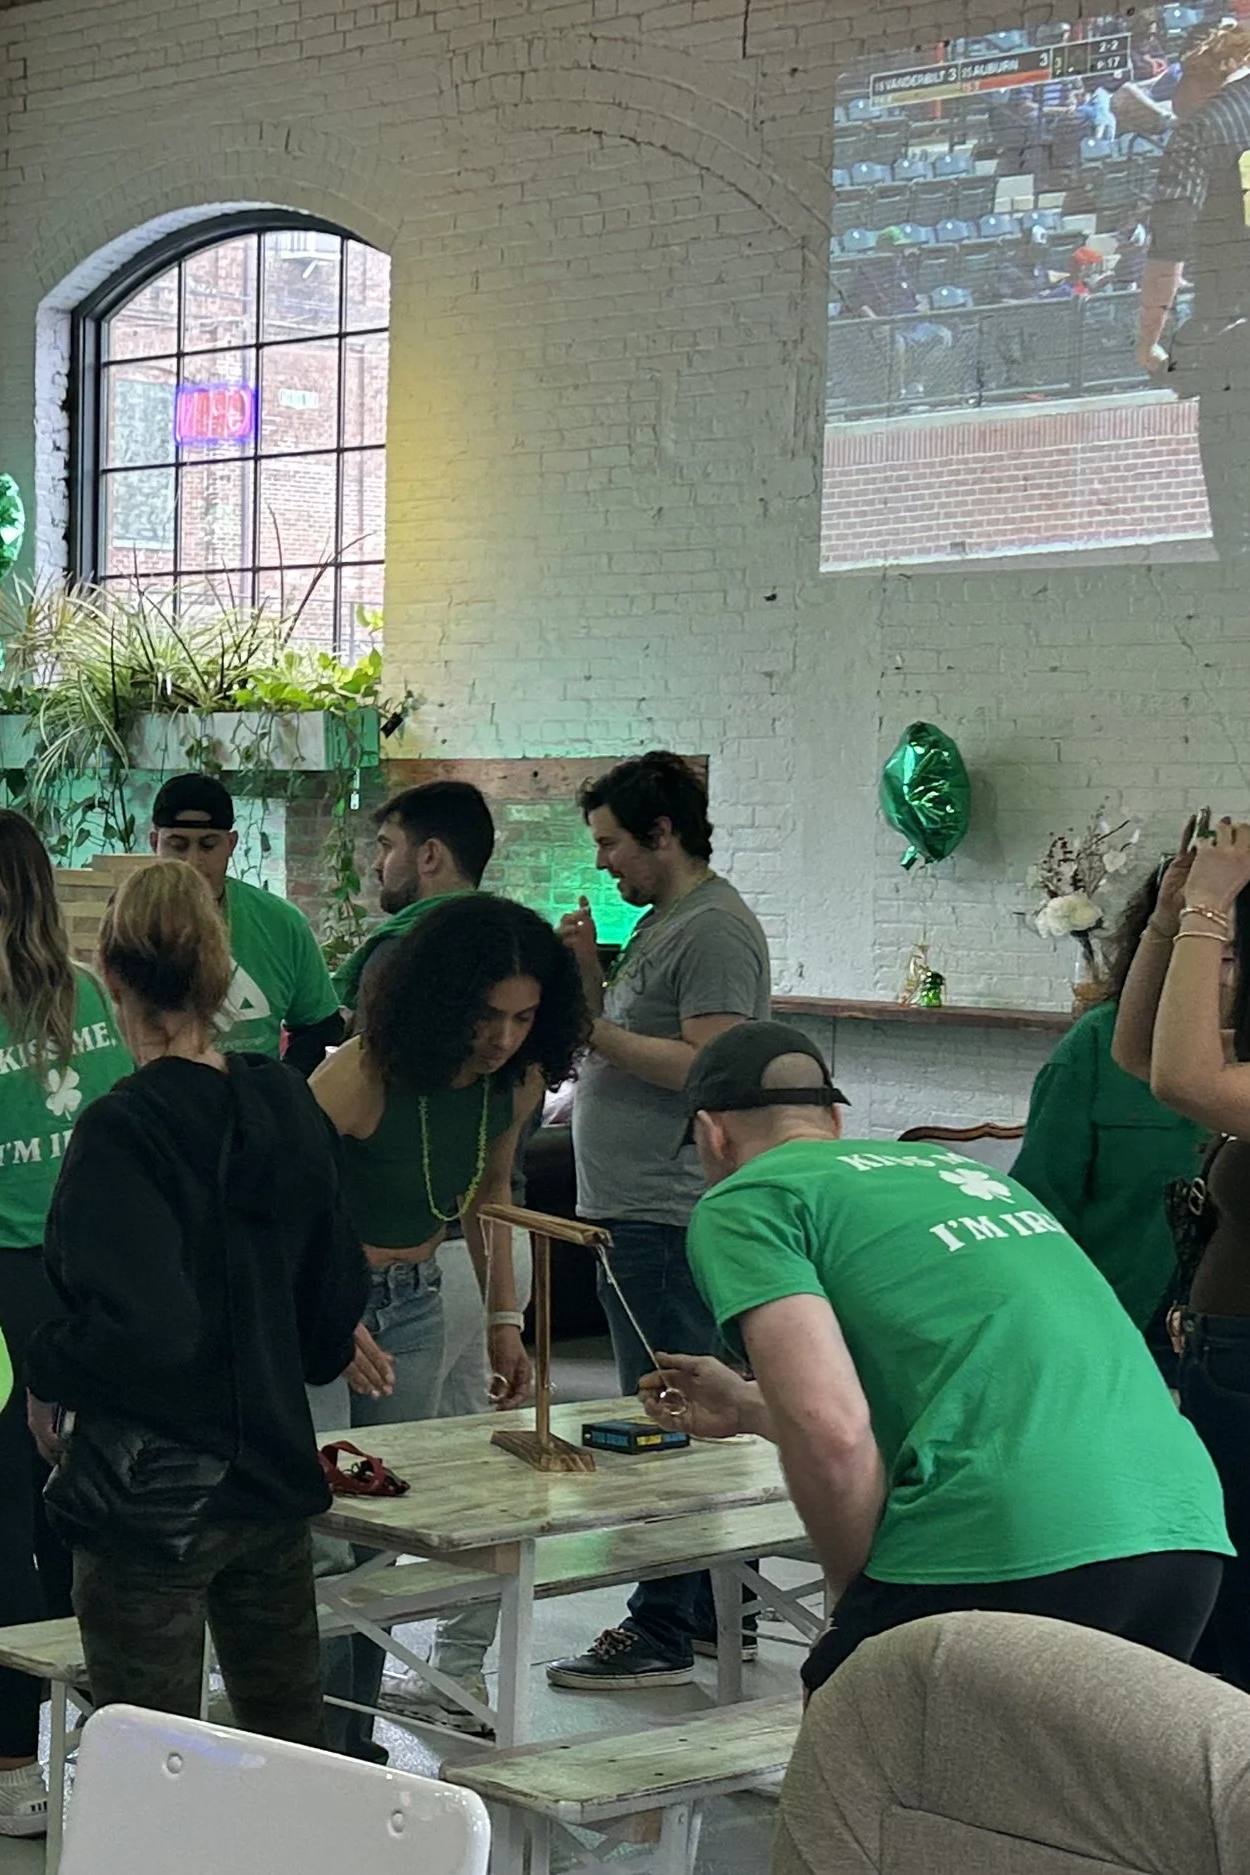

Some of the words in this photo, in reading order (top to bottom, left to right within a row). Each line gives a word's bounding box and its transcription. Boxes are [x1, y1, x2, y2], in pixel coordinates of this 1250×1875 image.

[1099, 40, 1119, 52] 2-2
[972, 59, 1019, 77] AUBURN
[1039, 53, 1048, 67] 3
[885, 70, 945, 90] VANDERBILT
[948, 68, 957, 81] 3
[929, 1215, 1009, 1252] I'M
